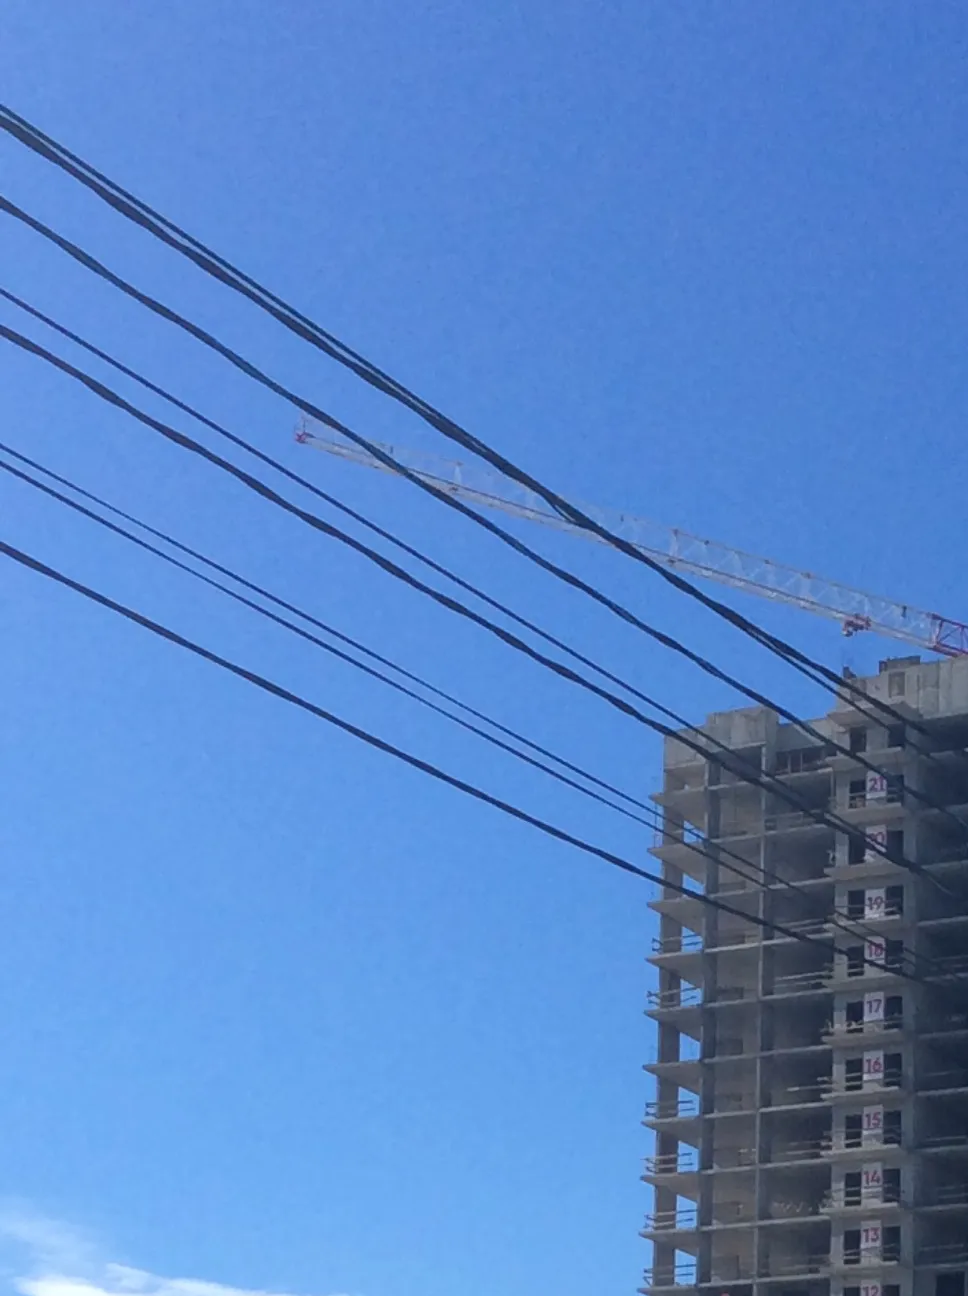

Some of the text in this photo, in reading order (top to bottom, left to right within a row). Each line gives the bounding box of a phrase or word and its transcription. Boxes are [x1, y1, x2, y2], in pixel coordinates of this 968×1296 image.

[869, 776, 885, 792] 21
[867, 896, 884, 911] 19
[867, 999, 882, 1013] 17
[866, 1058, 881, 1073] 16
[865, 1112, 880, 1128] 15
[864, 1170, 880, 1185] 14
[863, 1227, 880, 1242] 13
